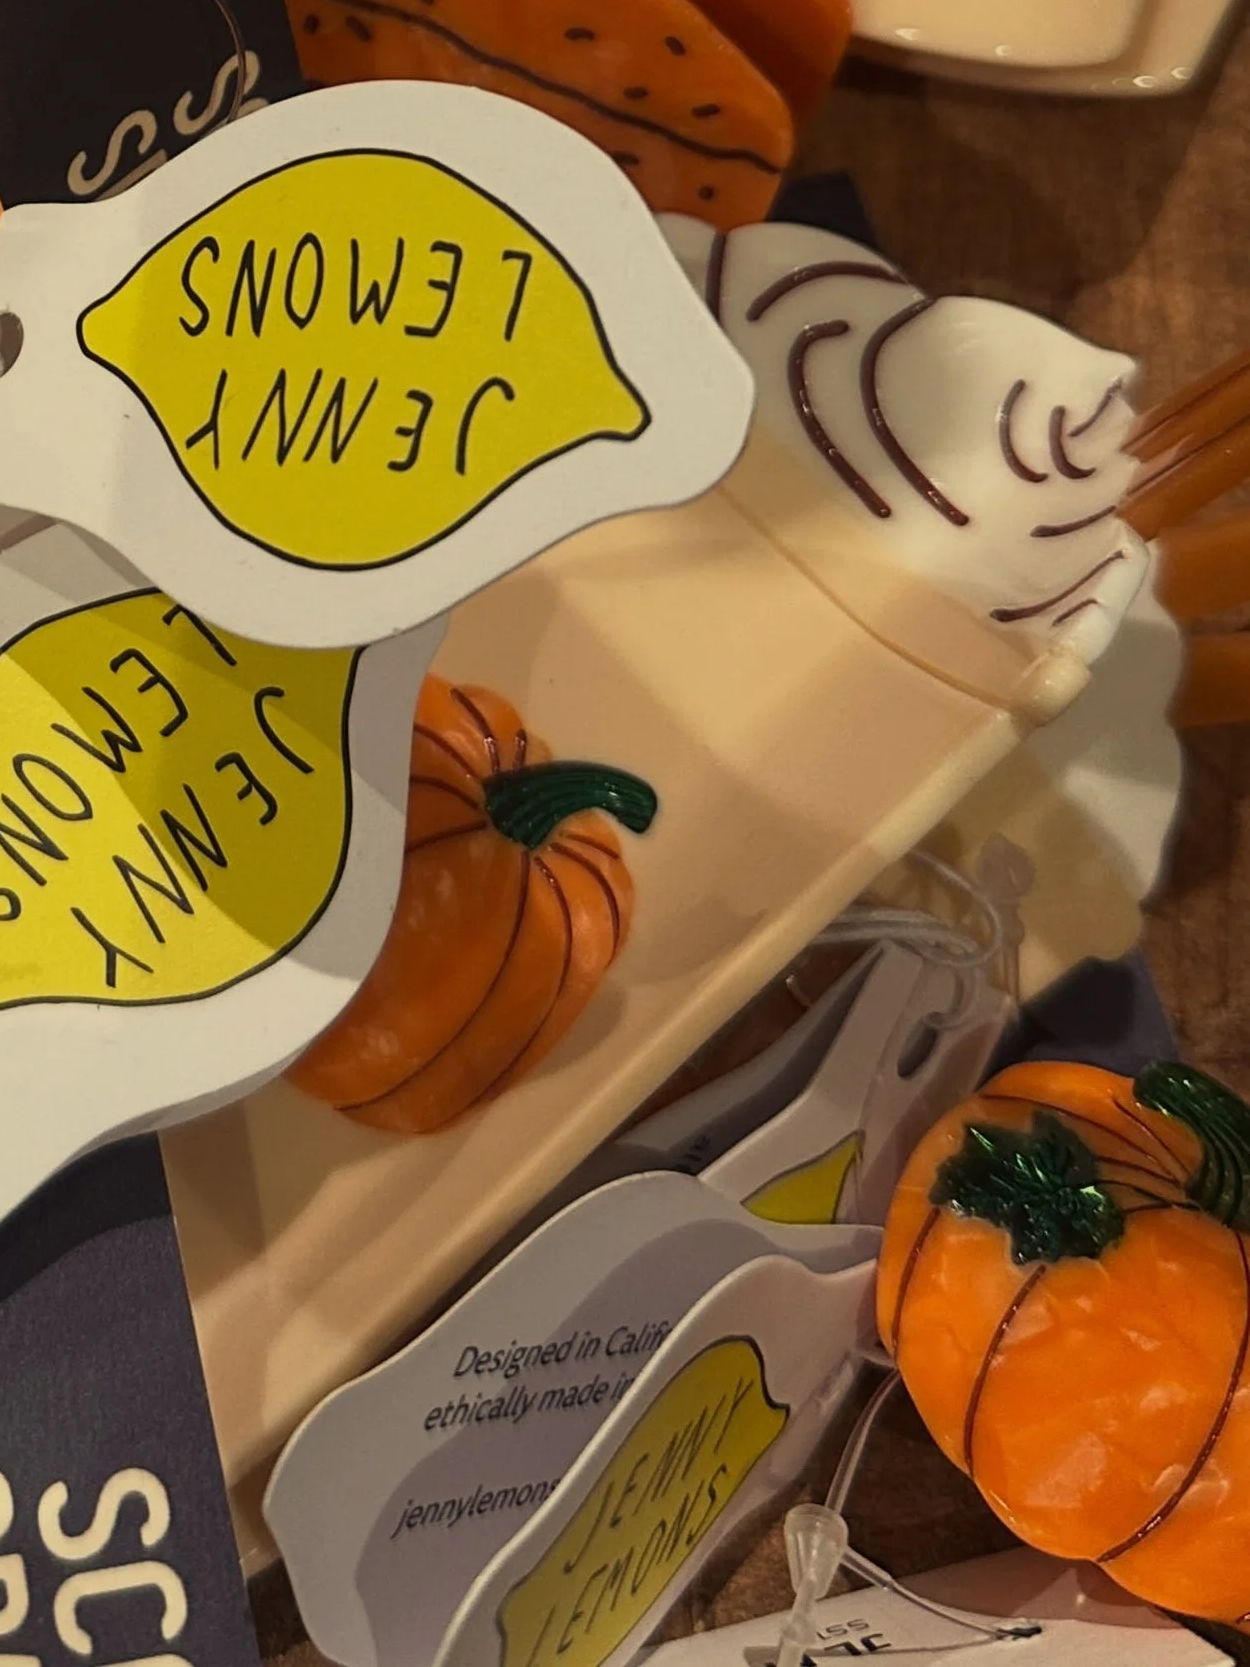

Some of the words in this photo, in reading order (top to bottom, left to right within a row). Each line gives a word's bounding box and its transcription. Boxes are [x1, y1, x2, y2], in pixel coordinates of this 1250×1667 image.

[179, 233, 533, 342] LEMONS
[184, 367, 516, 476] JENNY
[70, 685, 315, 989] JENNY
[423, 1384, 539, 1432] ethically
[539, 1375, 610, 1412] made
[452, 1331, 578, 1380] Designed
[574, 1330, 602, 1360] in
[605, 1319, 674, 1359] Calif
[562, 1377, 755, 1576] JENNY
